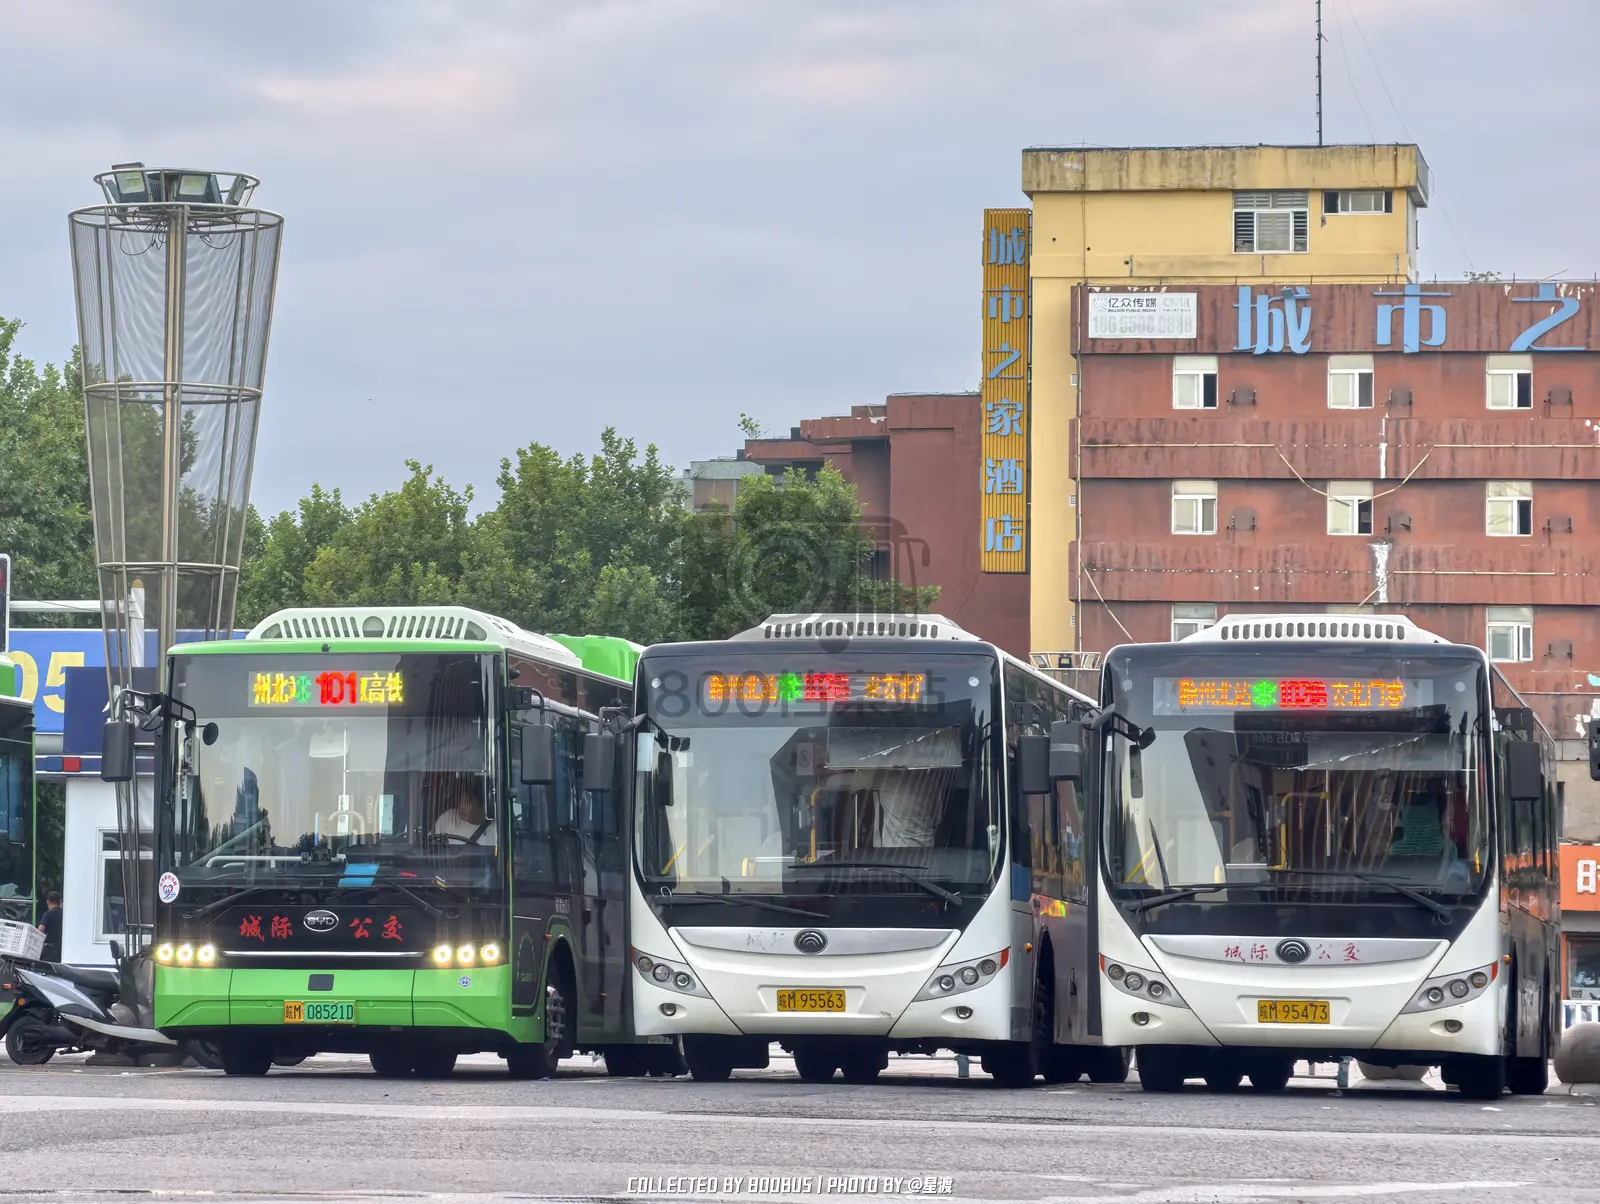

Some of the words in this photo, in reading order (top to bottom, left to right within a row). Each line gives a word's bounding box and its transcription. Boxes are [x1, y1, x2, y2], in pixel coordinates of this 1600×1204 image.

[1108, 297, 1157, 308] 亿众传媒
[1232, 282, 1586, 356] 城市之
[985, 227, 1026, 553] 城市之家酒店
[315, 672, 357, 704] 101
[239, 914, 293, 943] 城际
[349, 915, 404, 943] 公交
[307, 917, 335, 926] BYD
